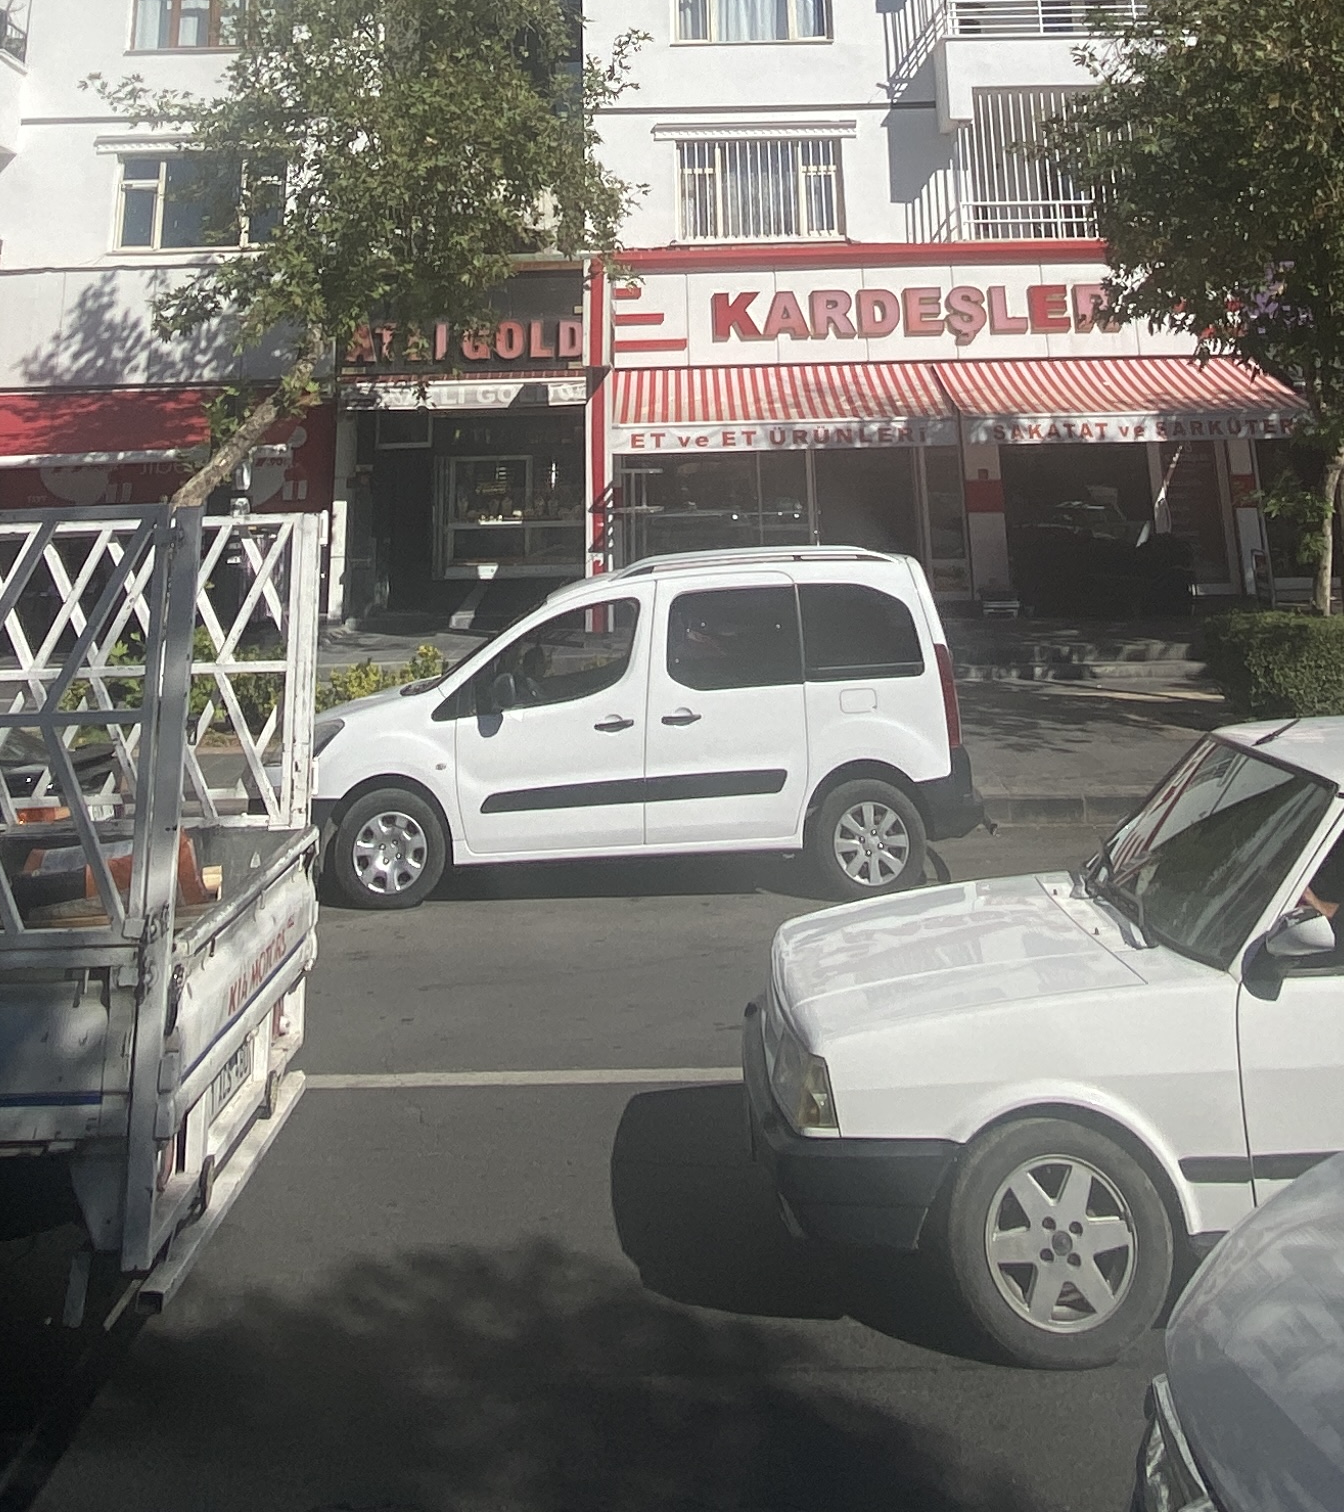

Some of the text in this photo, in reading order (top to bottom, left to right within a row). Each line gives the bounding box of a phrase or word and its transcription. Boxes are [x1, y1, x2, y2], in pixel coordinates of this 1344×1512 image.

[711, 285, 1123, 346] KARDEŞLER
[460, 319, 583, 361] GOLD
[630, 432, 666, 449] ET
[677, 434, 709, 448] ve
[721, 430, 757, 447] ET
[992, 422, 1109, 440] SAKATAT
